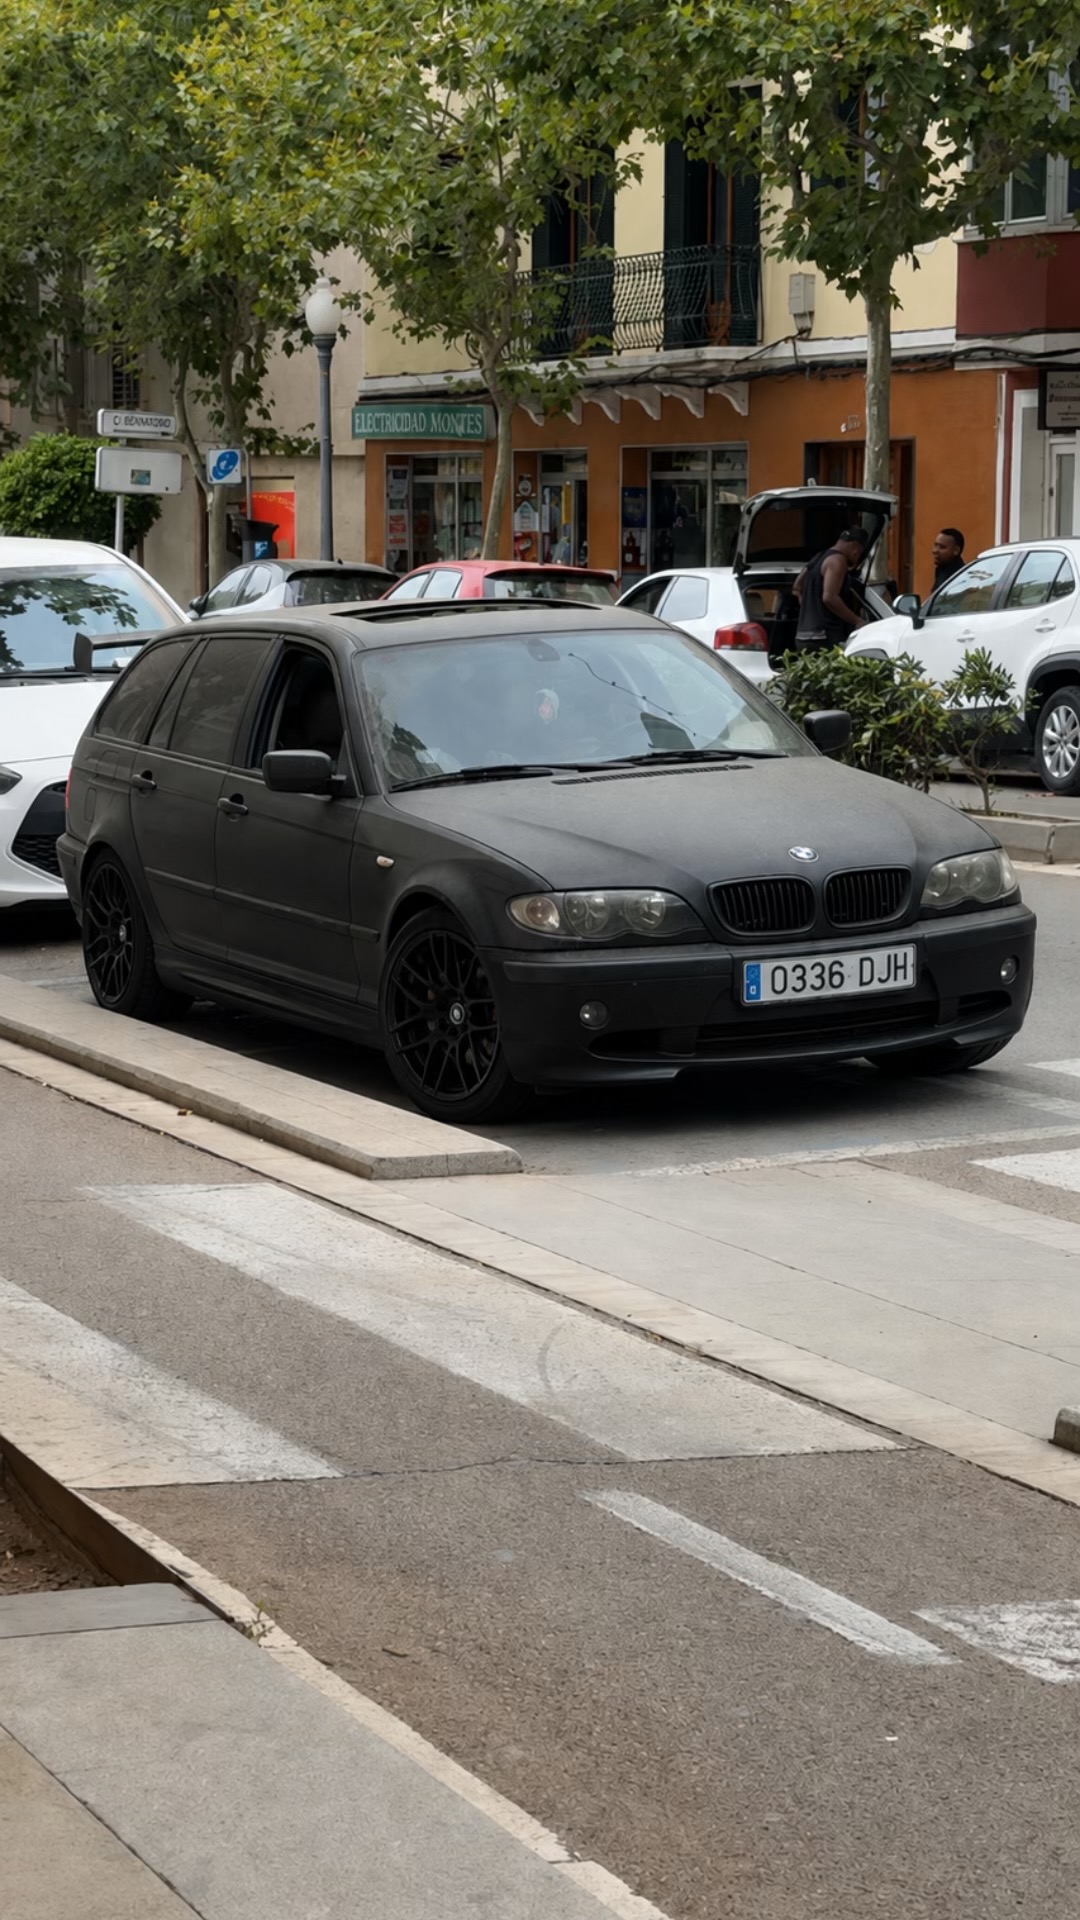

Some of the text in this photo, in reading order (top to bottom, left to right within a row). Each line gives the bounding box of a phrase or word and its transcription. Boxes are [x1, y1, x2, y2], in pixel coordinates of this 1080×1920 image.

[355, 412, 482, 436] ELECTRICIDAD MONTES
[771, 952, 908, 995] 0336 DJH
